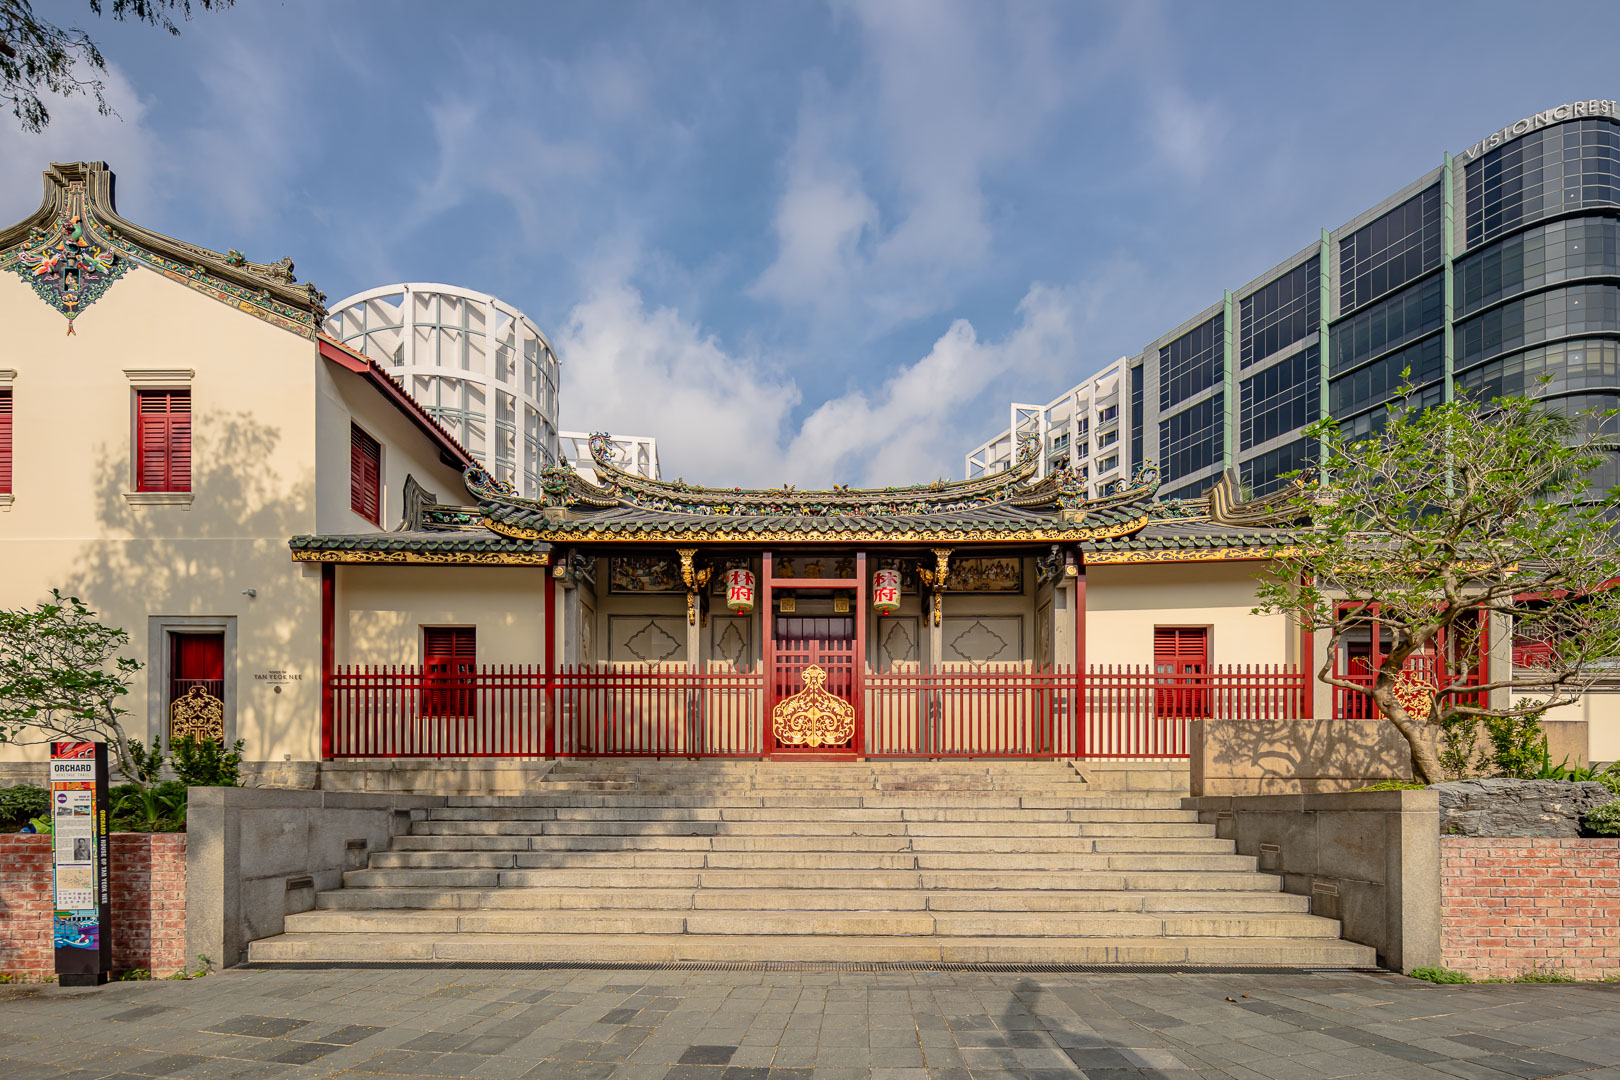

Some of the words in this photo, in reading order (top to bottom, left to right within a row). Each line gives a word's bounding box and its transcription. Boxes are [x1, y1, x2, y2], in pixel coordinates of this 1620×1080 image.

[1465, 99, 1617, 159] VISIONCREST
[730, 570, 754, 601] 林府
[872, 571, 898, 603] 林府
[54, 764, 92, 772] ORCHARD
